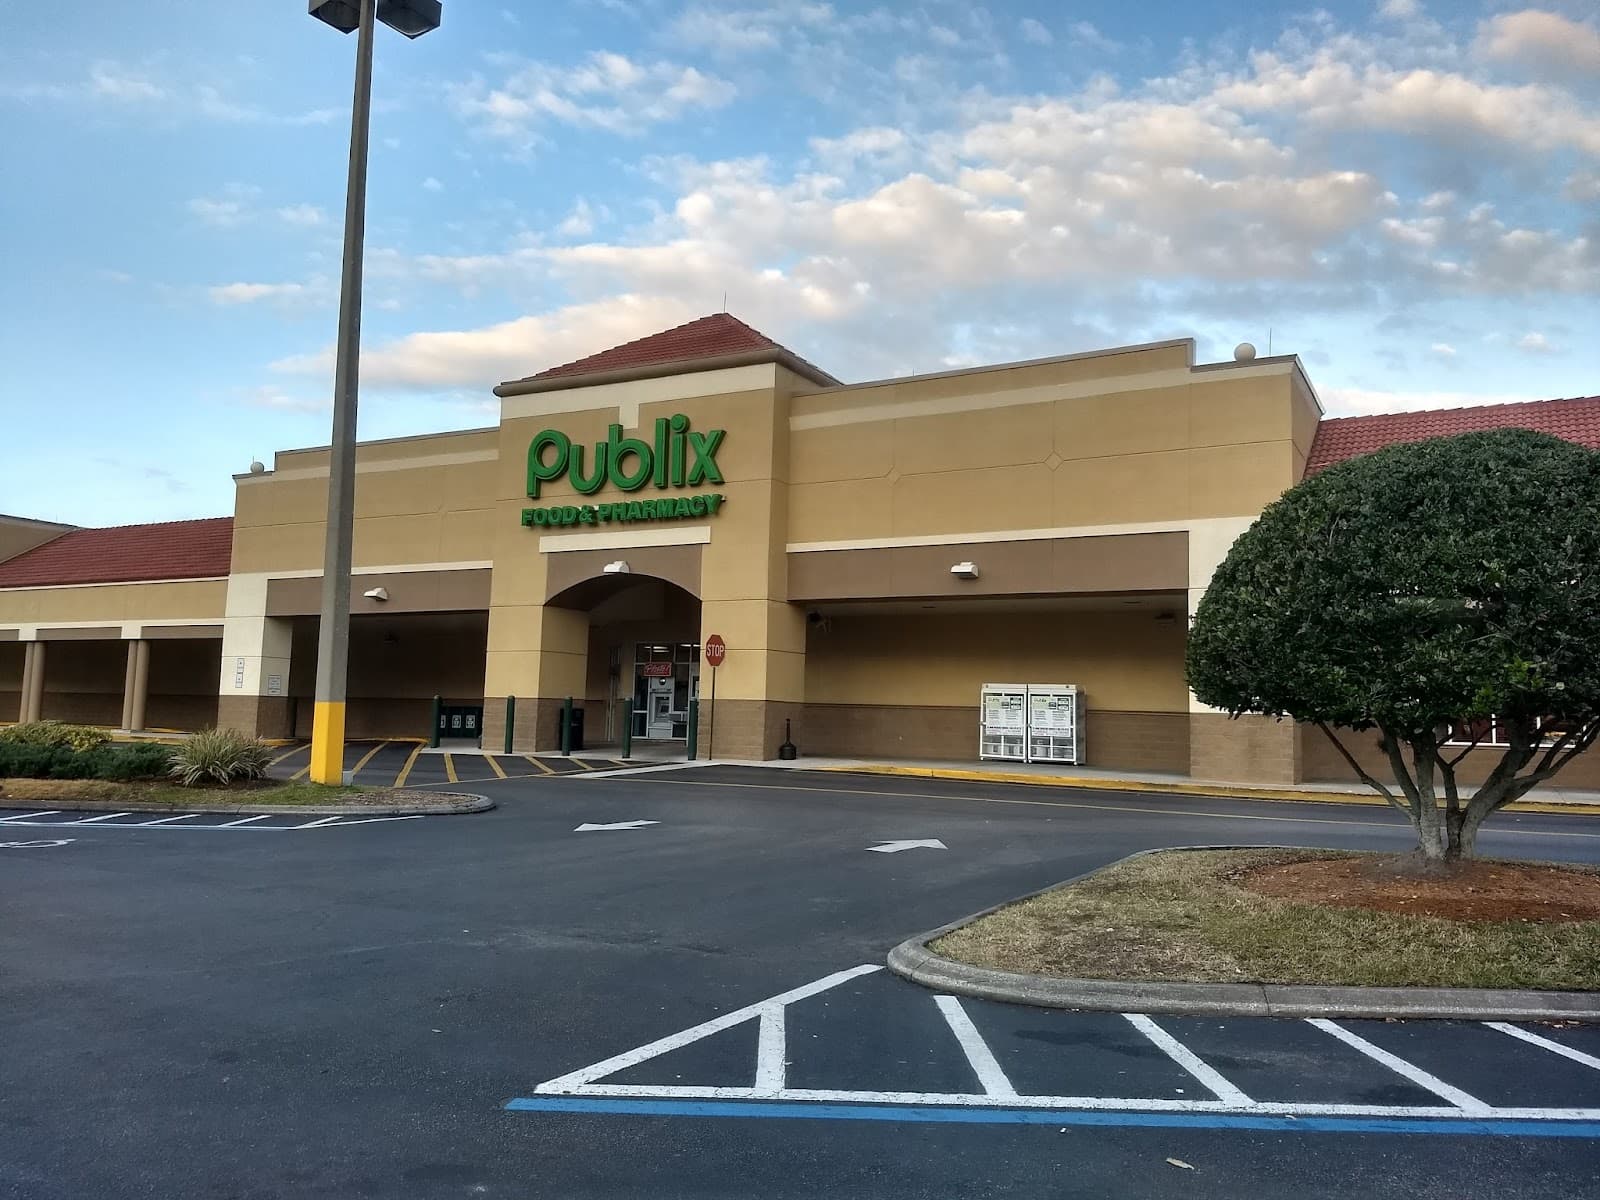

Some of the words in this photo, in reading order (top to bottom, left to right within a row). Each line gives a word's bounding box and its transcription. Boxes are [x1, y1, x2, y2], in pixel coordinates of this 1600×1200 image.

[527, 414, 726, 497] Publix
[521, 507, 579, 526] FOOD
[578, 505, 599, 524] &
[598, 494, 722, 519] PHARMACY
[706, 644, 725, 656] STOP
